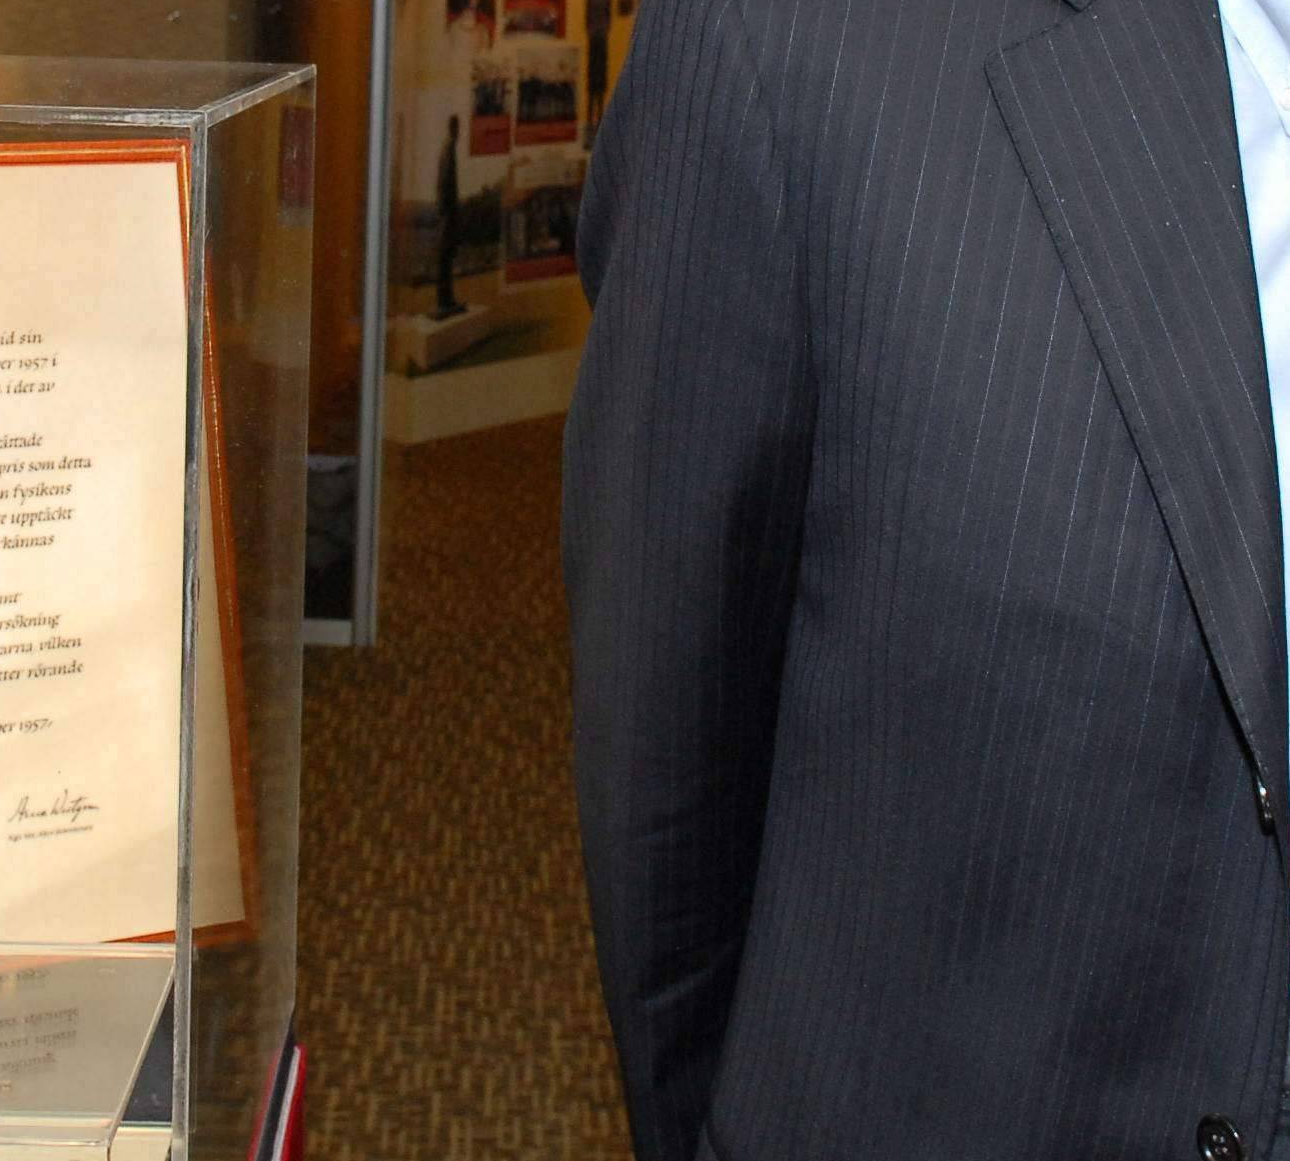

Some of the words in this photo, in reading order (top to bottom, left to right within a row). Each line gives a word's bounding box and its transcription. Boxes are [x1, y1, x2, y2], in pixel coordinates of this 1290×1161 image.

[19, 329, 43, 345] sin
[18, 358, 49, 372] 1957
[13, 379, 37, 395] det
[37, 381, 56, 393] av
[28, 460, 55, 473] som
[57, 455, 93, 471] detta
[12, 482, 73, 507] fysikens
[39, 636, 82, 651] vilken
